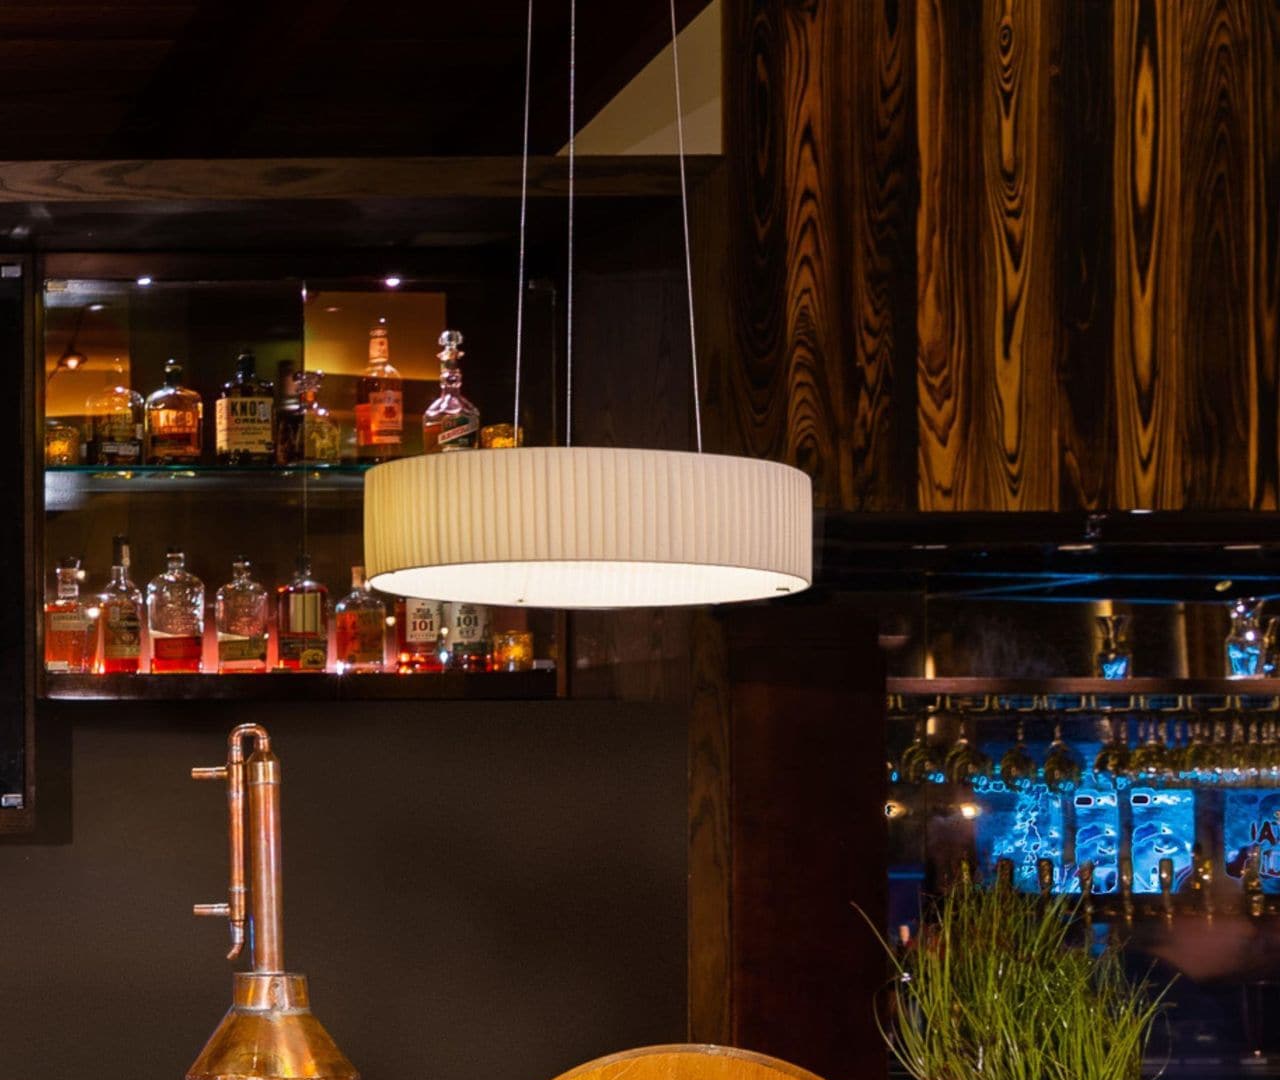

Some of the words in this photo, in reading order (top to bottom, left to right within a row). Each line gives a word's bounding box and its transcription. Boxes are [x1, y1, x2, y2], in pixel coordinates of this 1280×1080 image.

[230, 401, 265, 416] KNO
[412, 620, 434, 631] 101
[456, 616, 479, 627] 101
